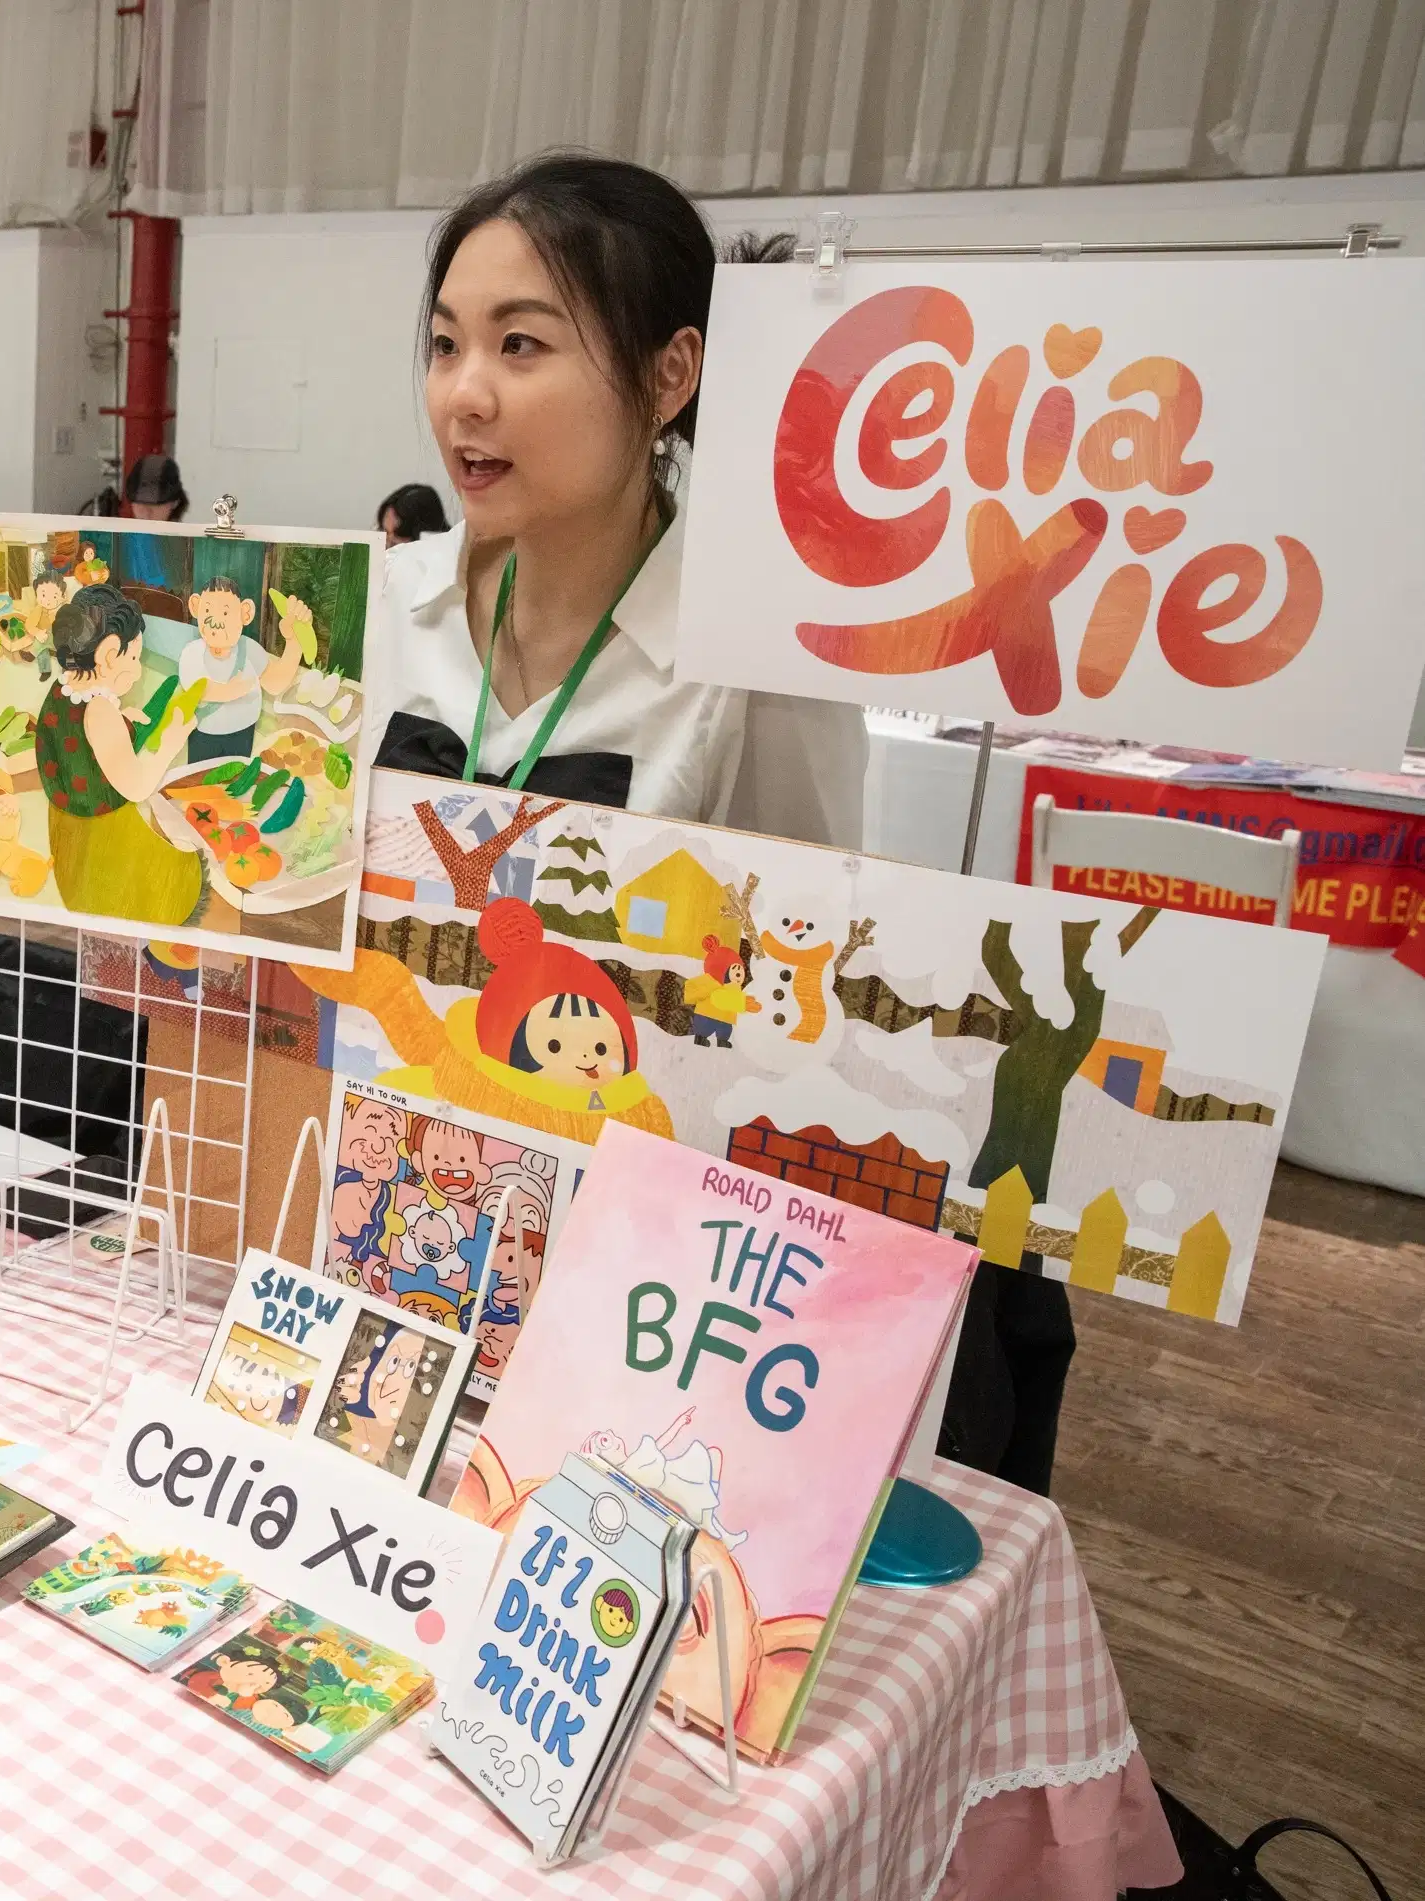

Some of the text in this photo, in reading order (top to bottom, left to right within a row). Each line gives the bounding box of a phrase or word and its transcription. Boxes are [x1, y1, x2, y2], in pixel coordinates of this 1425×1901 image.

[774, 286, 1213, 587] Celia
[796, 498, 1323, 716] Xie
[346, 1080, 407, 1106] SAY HI TO OUR
[701, 1166, 846, 1242] ROALD DAHL
[251, 1267, 345, 1325] SNOW
[700, 1220, 824, 1319] THE
[260, 1301, 316, 1345] DAY
[626, 1281, 820, 1433] BFG
[300, 1507, 436, 1613] Xie
